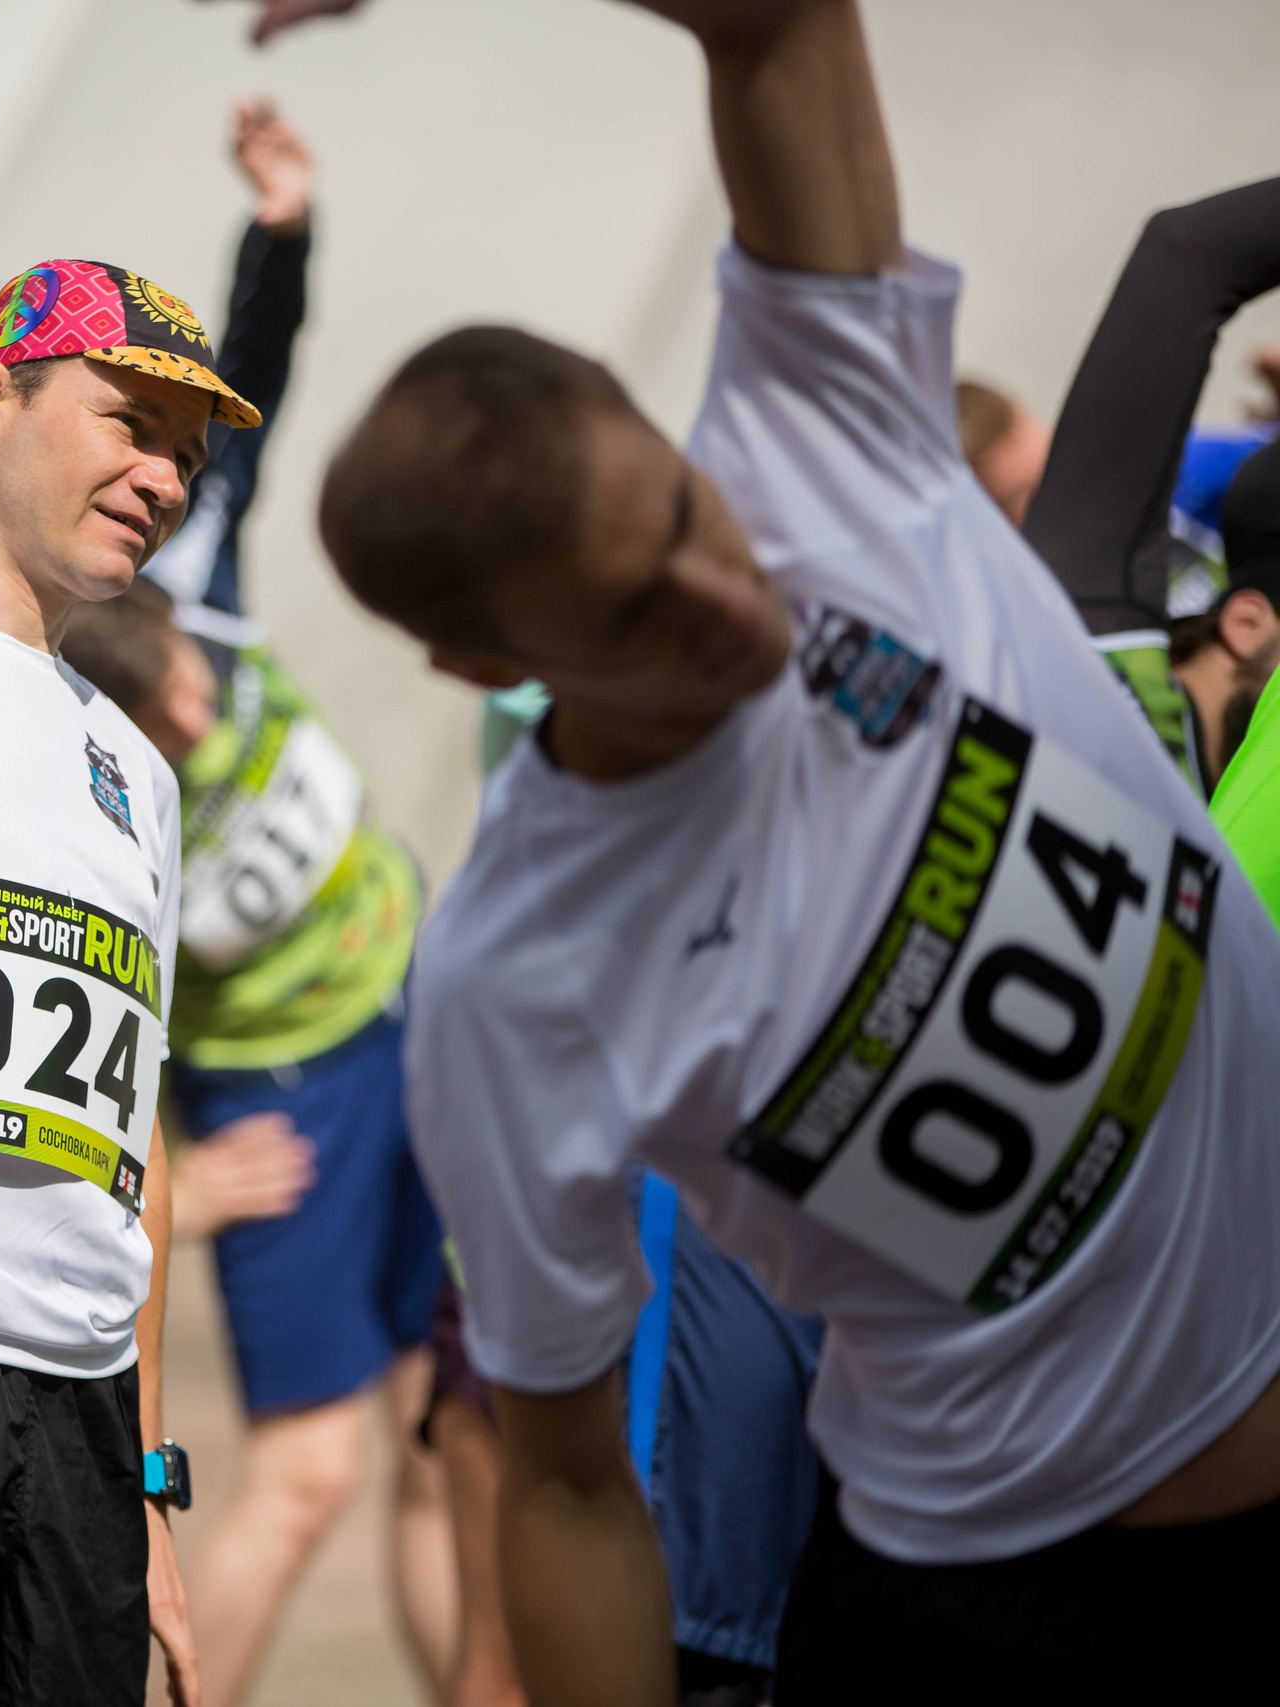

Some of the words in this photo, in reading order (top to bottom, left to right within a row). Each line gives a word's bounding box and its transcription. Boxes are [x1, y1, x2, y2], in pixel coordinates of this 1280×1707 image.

[906, 733, 1021, 940] RUN
[47, 902, 86, 923] ЗАБЕГ
[83, 913, 154, 1004] RUN
[878, 809, 1150, 1219] 004
[38, 1126, 90, 1162] СОСНОВКА
[91, 1147, 111, 1174] ПАРК
